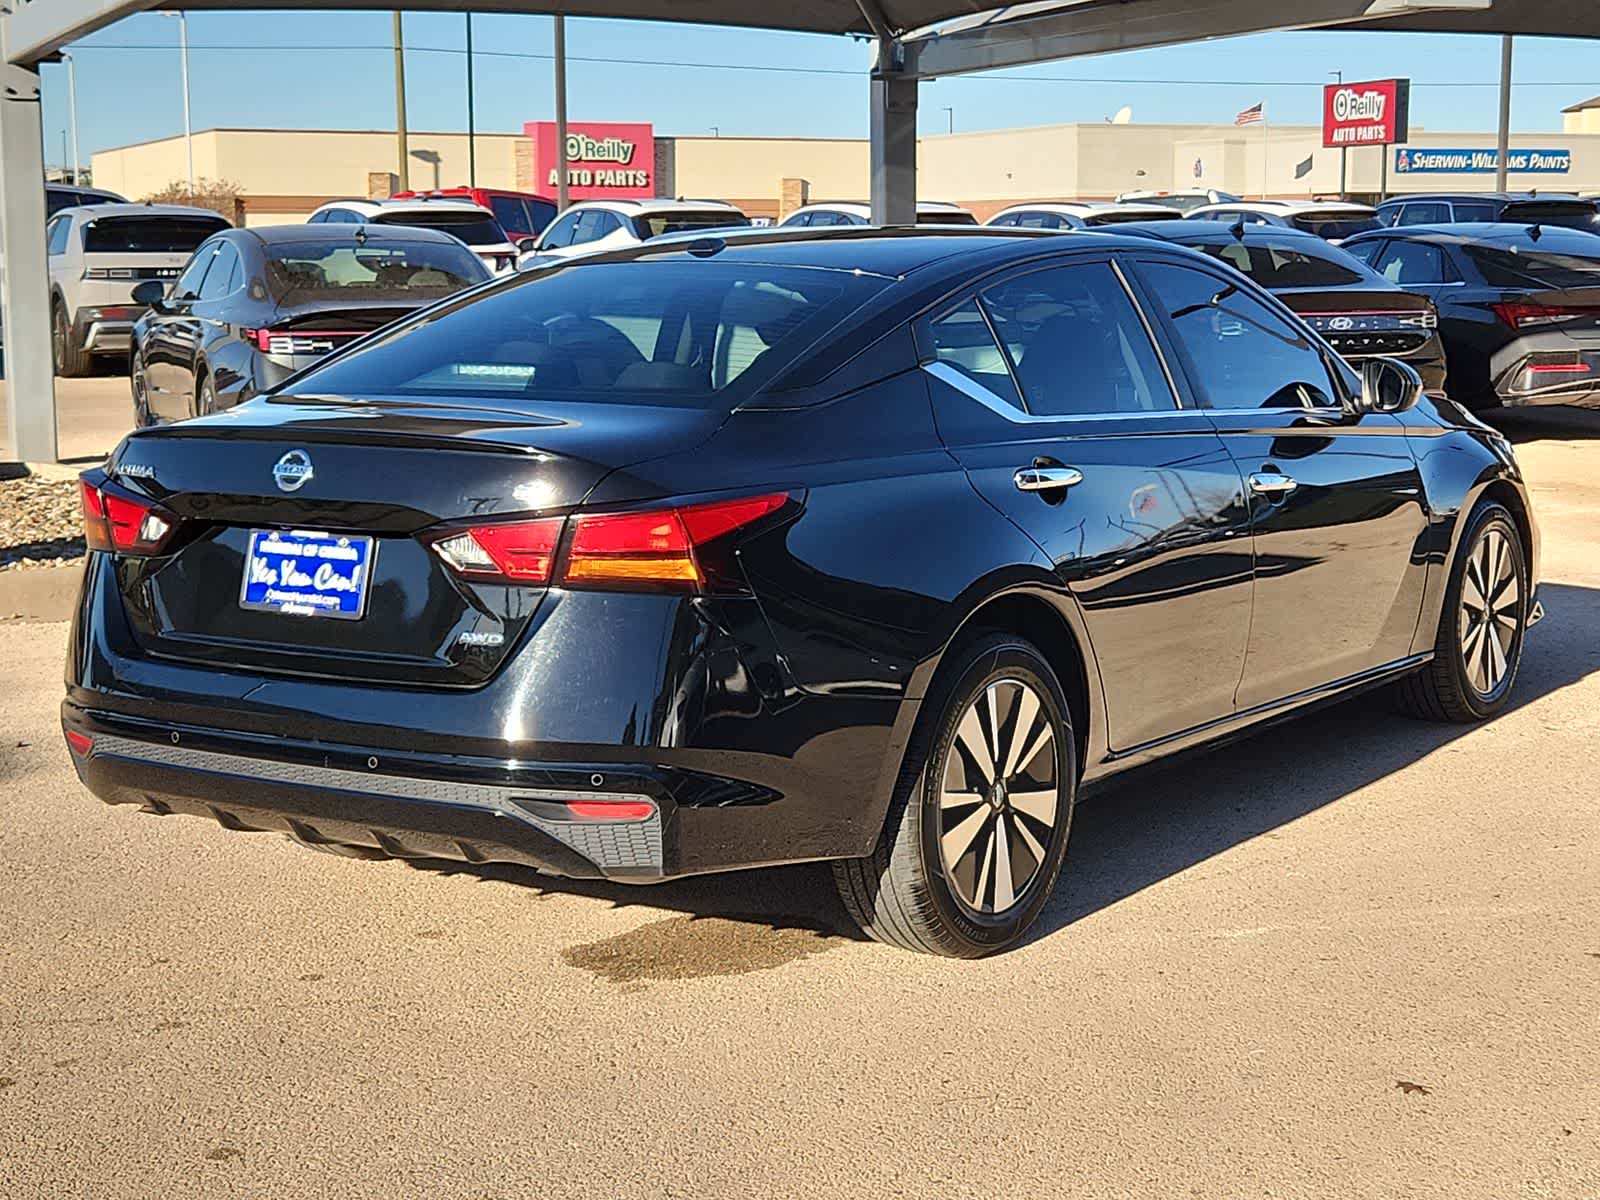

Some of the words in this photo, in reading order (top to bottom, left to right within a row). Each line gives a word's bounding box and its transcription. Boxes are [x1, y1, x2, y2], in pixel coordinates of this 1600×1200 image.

[1334, 90, 1386, 121] O'Reilly
[1332, 127, 1356, 143] AUTO
[1357, 125, 1386, 141] PARTS
[566, 135, 632, 163] O'Reilly
[1412, 152, 1528, 169] SHERWIN-WILLMS
[1529, 153, 1570, 169] PAINTS
[548, 168, 592, 186] ATO
[595, 169, 648, 187] PARTS
